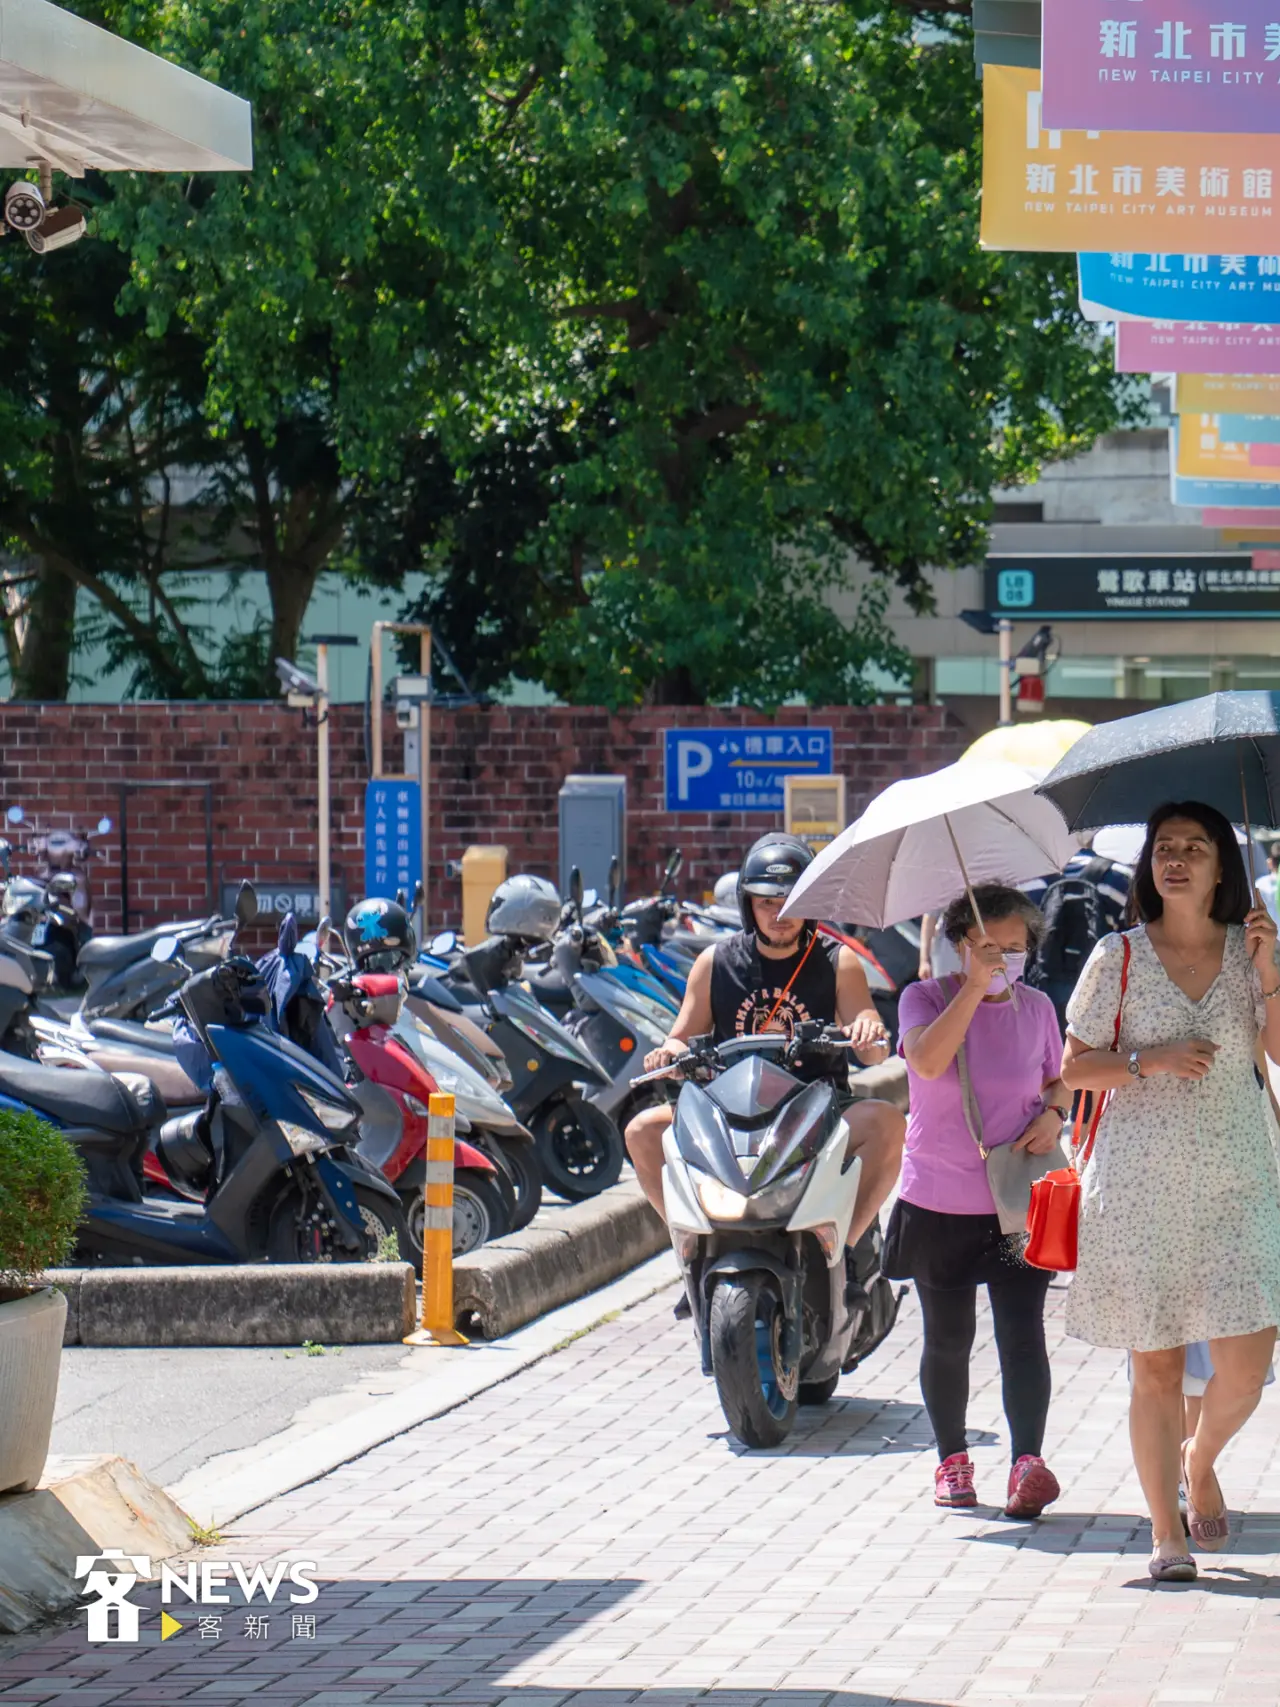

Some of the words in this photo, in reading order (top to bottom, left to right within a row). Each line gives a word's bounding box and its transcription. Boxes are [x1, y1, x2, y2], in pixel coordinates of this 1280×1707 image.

[1151, 70, 1211, 83] TAIPEI
[1223, 72, 1265, 84] CITY
[1026, 163, 1272, 199] 新北市美術館
[1066, 203, 1114, 214] TAIPEI
[1123, 204, 1156, 215] CITY
[1166, 205, 1196, 216] ART
[1205, 206, 1272, 217] MUSEUM
[1143, 278, 1184, 288] TAIPEI
[1191, 279, 1221, 290] CITY
[1229, 281, 1255, 291] ART
[1098, 570, 1196, 593] 鶯歌車站
[745, 736, 825, 755] 機車入口
[677, 740, 713, 801] P
